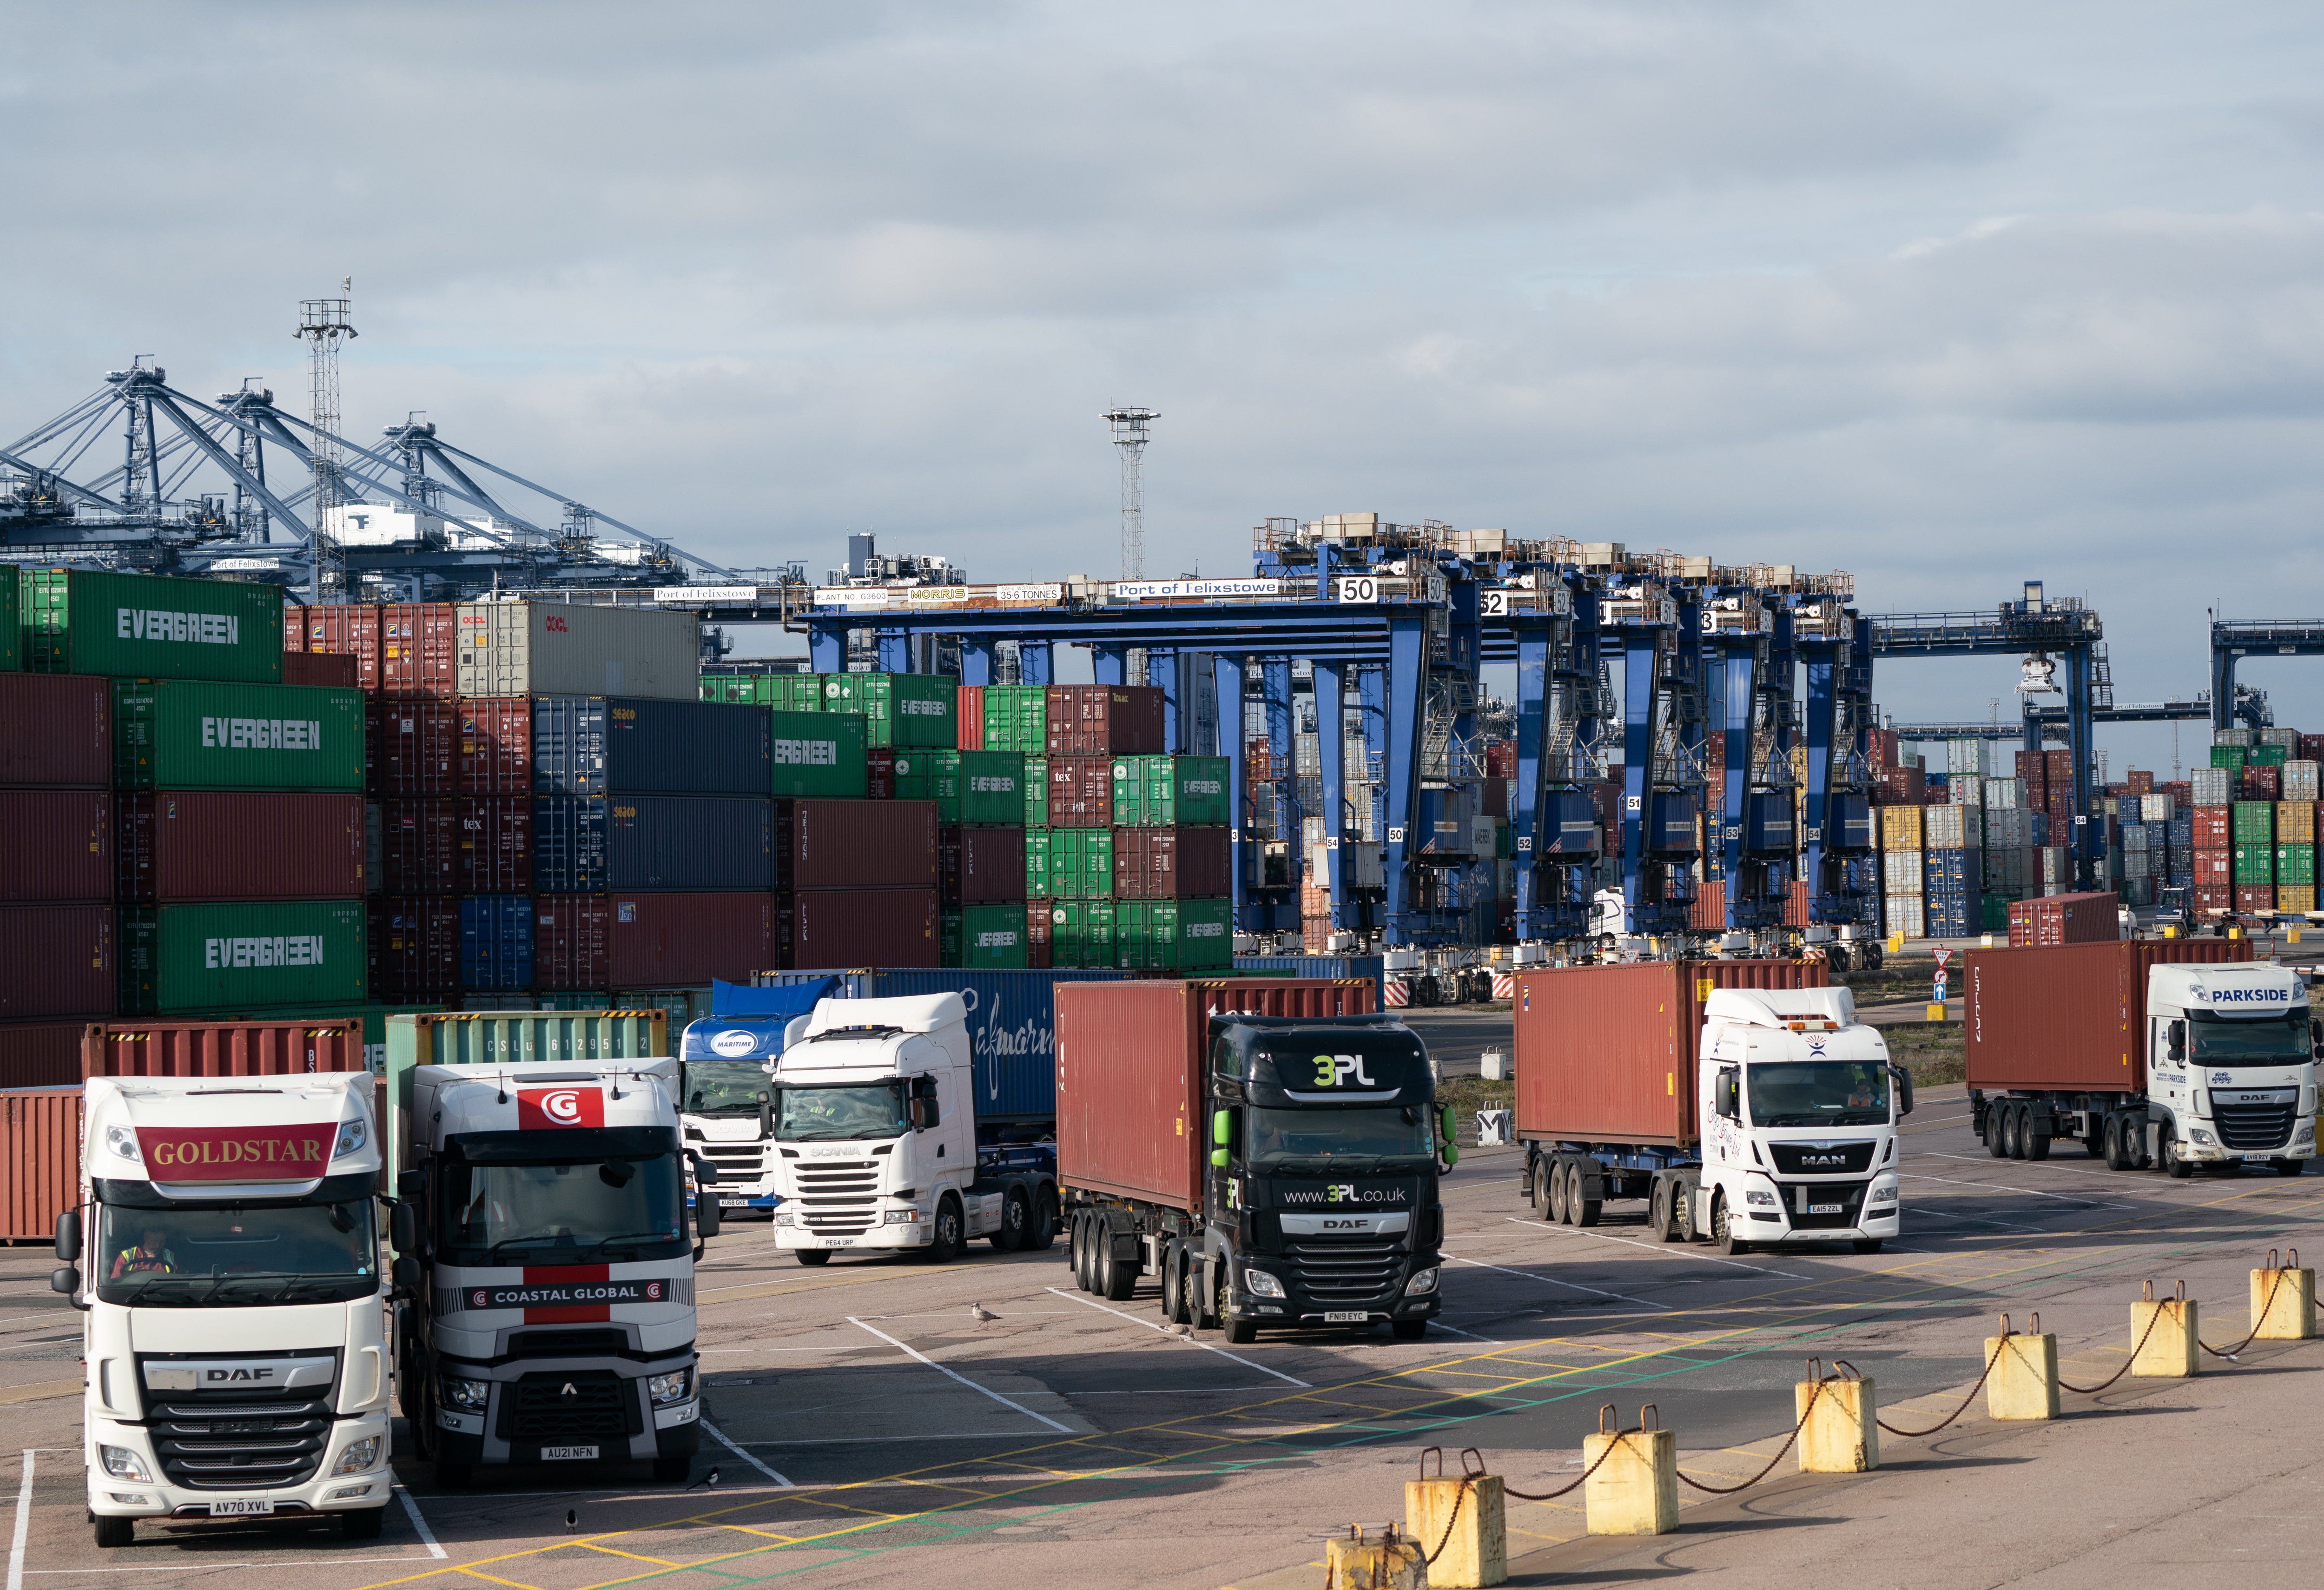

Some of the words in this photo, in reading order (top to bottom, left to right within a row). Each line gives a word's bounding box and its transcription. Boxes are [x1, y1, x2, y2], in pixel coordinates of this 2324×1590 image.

[239, 559, 277, 568] Felixstowe
[657, 590, 679, 599] Port
[683, 589, 695, 598] of
[697, 588, 754, 598] Felixstowe
[911, 589, 965, 600] MORRIS
[1022, 590, 1057, 598] TONNES
[1119, 584, 1156, 595] Port
[1162, 583, 1178, 594] of
[1186, 582, 1275, 593] Felixstowe
[1344, 580, 1373, 600] 50
[1430, 578, 1441, 601] 50
[1557, 593, 1565, 613] 52
[1664, 604, 1672, 623] 51
[118, 608, 238, 644] EVERGREEN
[1763, 611, 1771, 630] 53
[1843, 619, 1851, 638] 54
[613, 709, 635, 720] seaco
[901, 700, 946, 716] EVERGREEN
[203, 717, 320, 749] EVERGREEN
[1055, 772, 1071, 782] tex
[971, 777, 1014, 791] EVERGREEN
[1629, 799, 1640, 807] 51
[614, 806, 635, 817] seaco
[463, 817, 482, 830] tex
[1390, 830, 1402, 840] 50
[1727, 829, 1737, 837] 53
[1809, 830, 1819, 838] 54
[1519, 839, 1530, 848] 52
[206, 935, 323, 968] EVERGREEN
[2213, 989, 2288, 1002] PARKSIDE
[552, 1037, 621, 1051] 612951
[640, 1037, 647, 1049] 2
[717, 1040, 753, 1049] MARITIME
[1314, 1055, 1375, 1086] 3PL
[2169, 1074, 2185, 1084] PARKSIDE
[155, 1140, 323, 1164] GOLDSTAR
[811, 1146, 861, 1157] SCANIA
[1802, 1155, 1845, 1165] MAN
[1285, 1184, 1406, 1203] www.3PL.co.uk
[1324, 1220, 1367, 1229] DAF
[495, 1289, 569, 1303] COASTAL
[574, 1284, 639, 1300] GLOBAL
[207, 1368, 272, 1382] DAF
[548, 1448, 570, 1458] AU21
[573, 1447, 593, 1457] NFN
[216, 1502, 244, 1513] AV70
[248, 1501, 269, 1511] XVL
